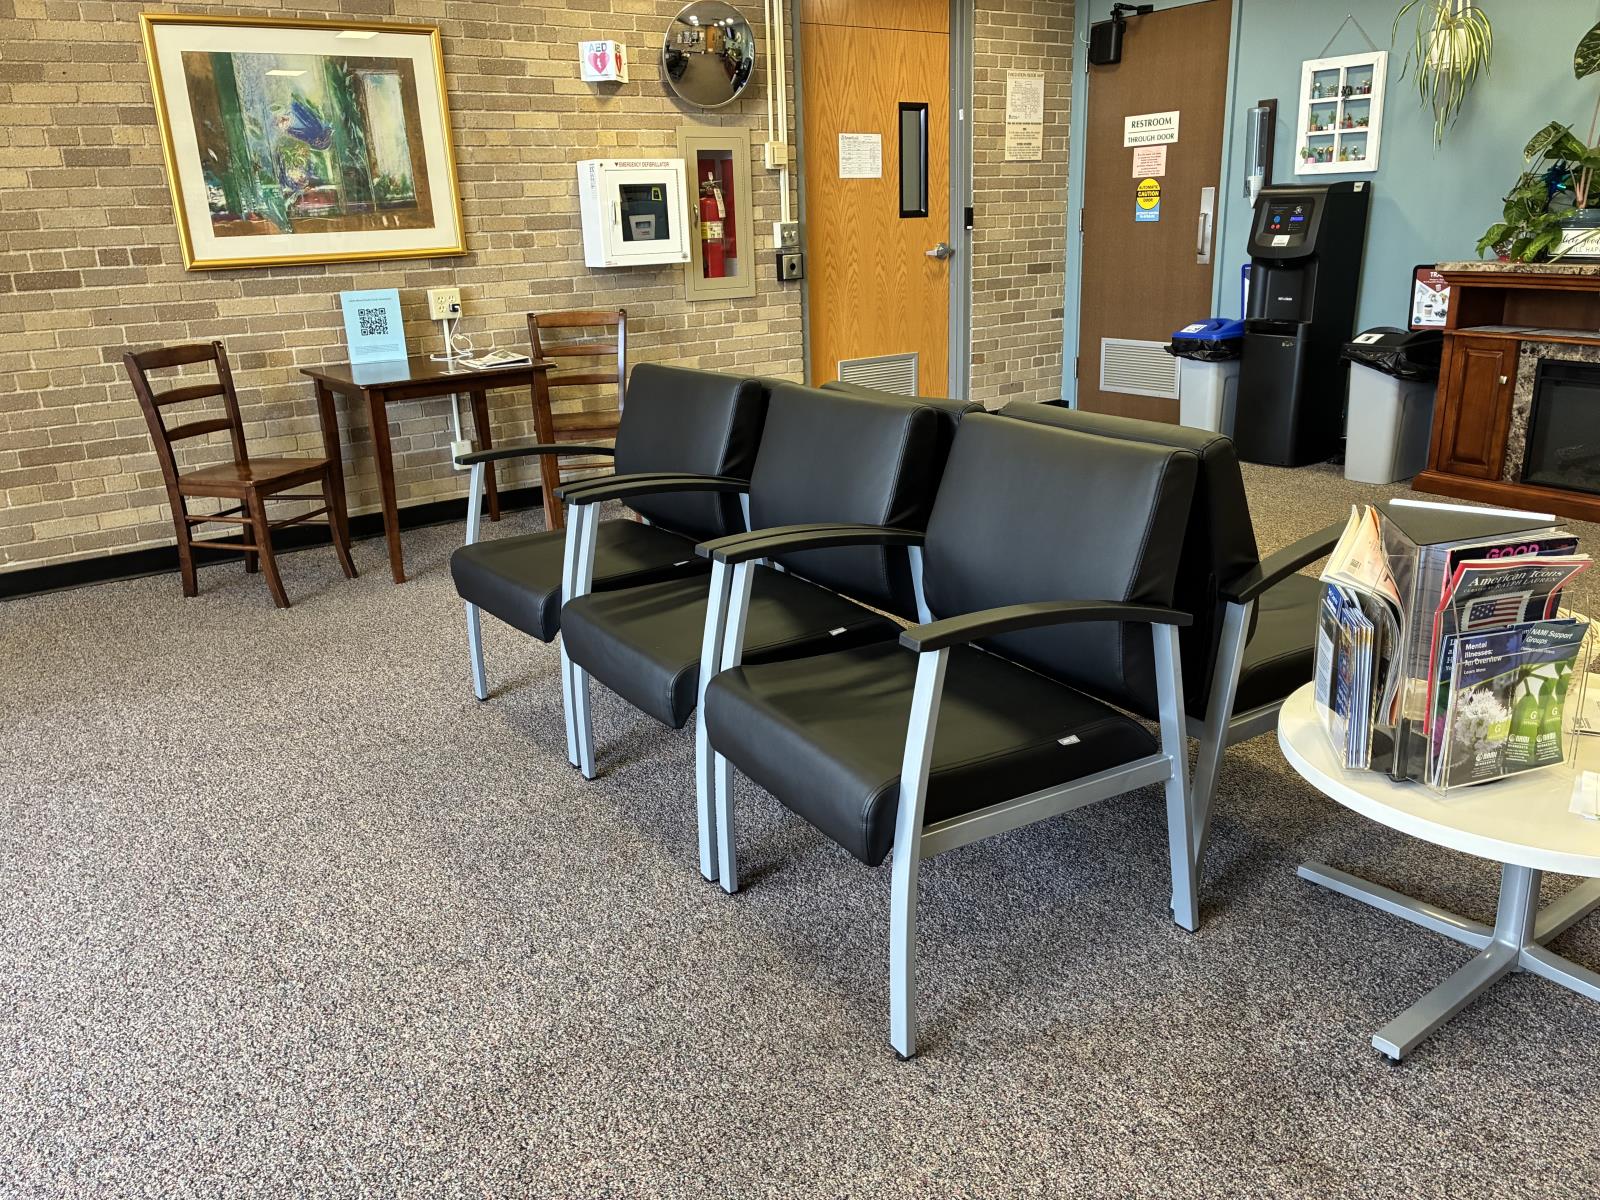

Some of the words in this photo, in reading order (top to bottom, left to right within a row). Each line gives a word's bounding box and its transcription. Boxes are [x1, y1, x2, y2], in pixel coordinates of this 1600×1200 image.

[588, 42, 608, 53] AED
[1131, 117, 1172, 129] RESTROOM
[1128, 134, 1155, 144] THROUGH
[1156, 132, 1175, 141] DOOR
[1468, 571, 1527, 587] American
[1529, 569, 1563, 578] Icons
[1495, 580, 1521, 589] RALPH
[1522, 577, 1558, 585] LAUREN
[1531, 628, 1549, 637] NAMI
[1548, 630, 1574, 640] Support
[1465, 641, 1487, 650] Mental
[1526, 636, 1548, 645] Groups
[1464, 649, 1494, 659] Illnesses:
[1464, 658, 1474, 667] An
[1474, 656, 1503, 666] Overview
